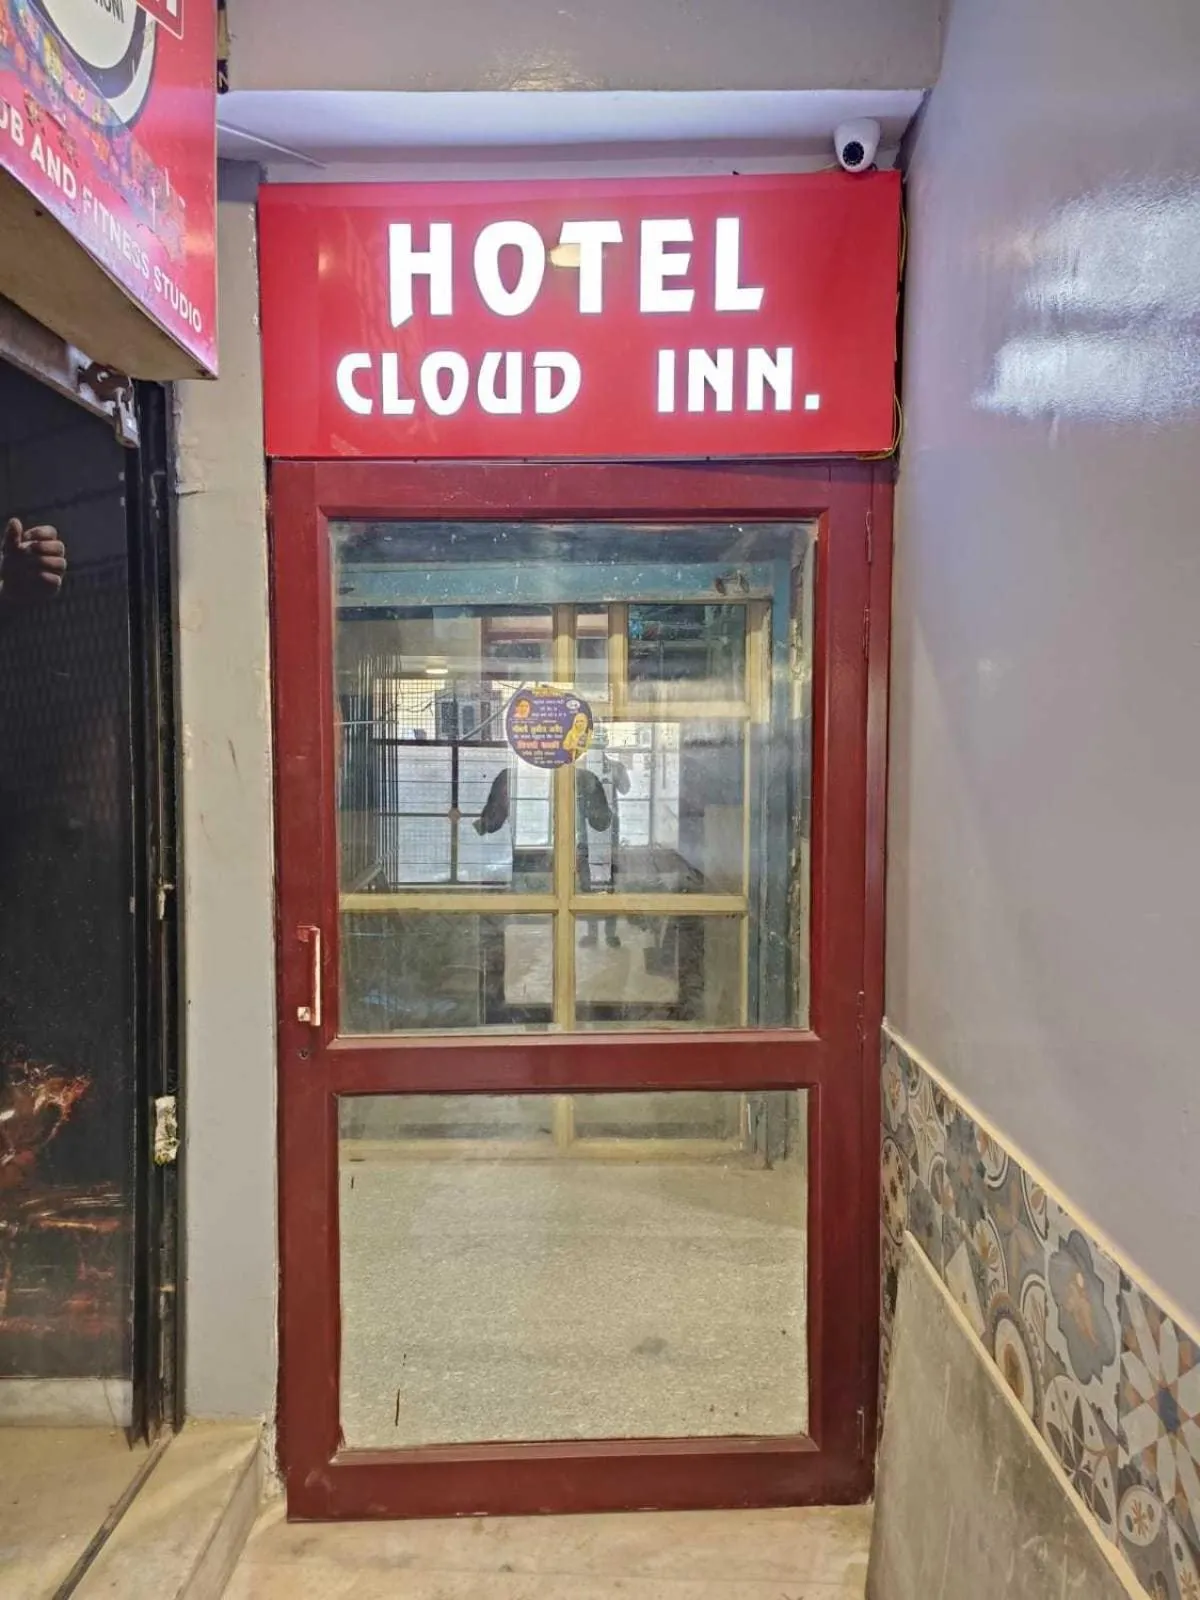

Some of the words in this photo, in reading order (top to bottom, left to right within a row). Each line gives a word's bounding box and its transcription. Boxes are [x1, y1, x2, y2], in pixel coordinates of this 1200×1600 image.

[30, 133, 76, 199] AND
[82, 186, 150, 280] FITNESS
[153, 265, 202, 333] STUDIO
[388, 217, 765, 328] HOTEL
[336, 350, 581, 416] CLOUD
[657, 347, 820, 413] INN.
